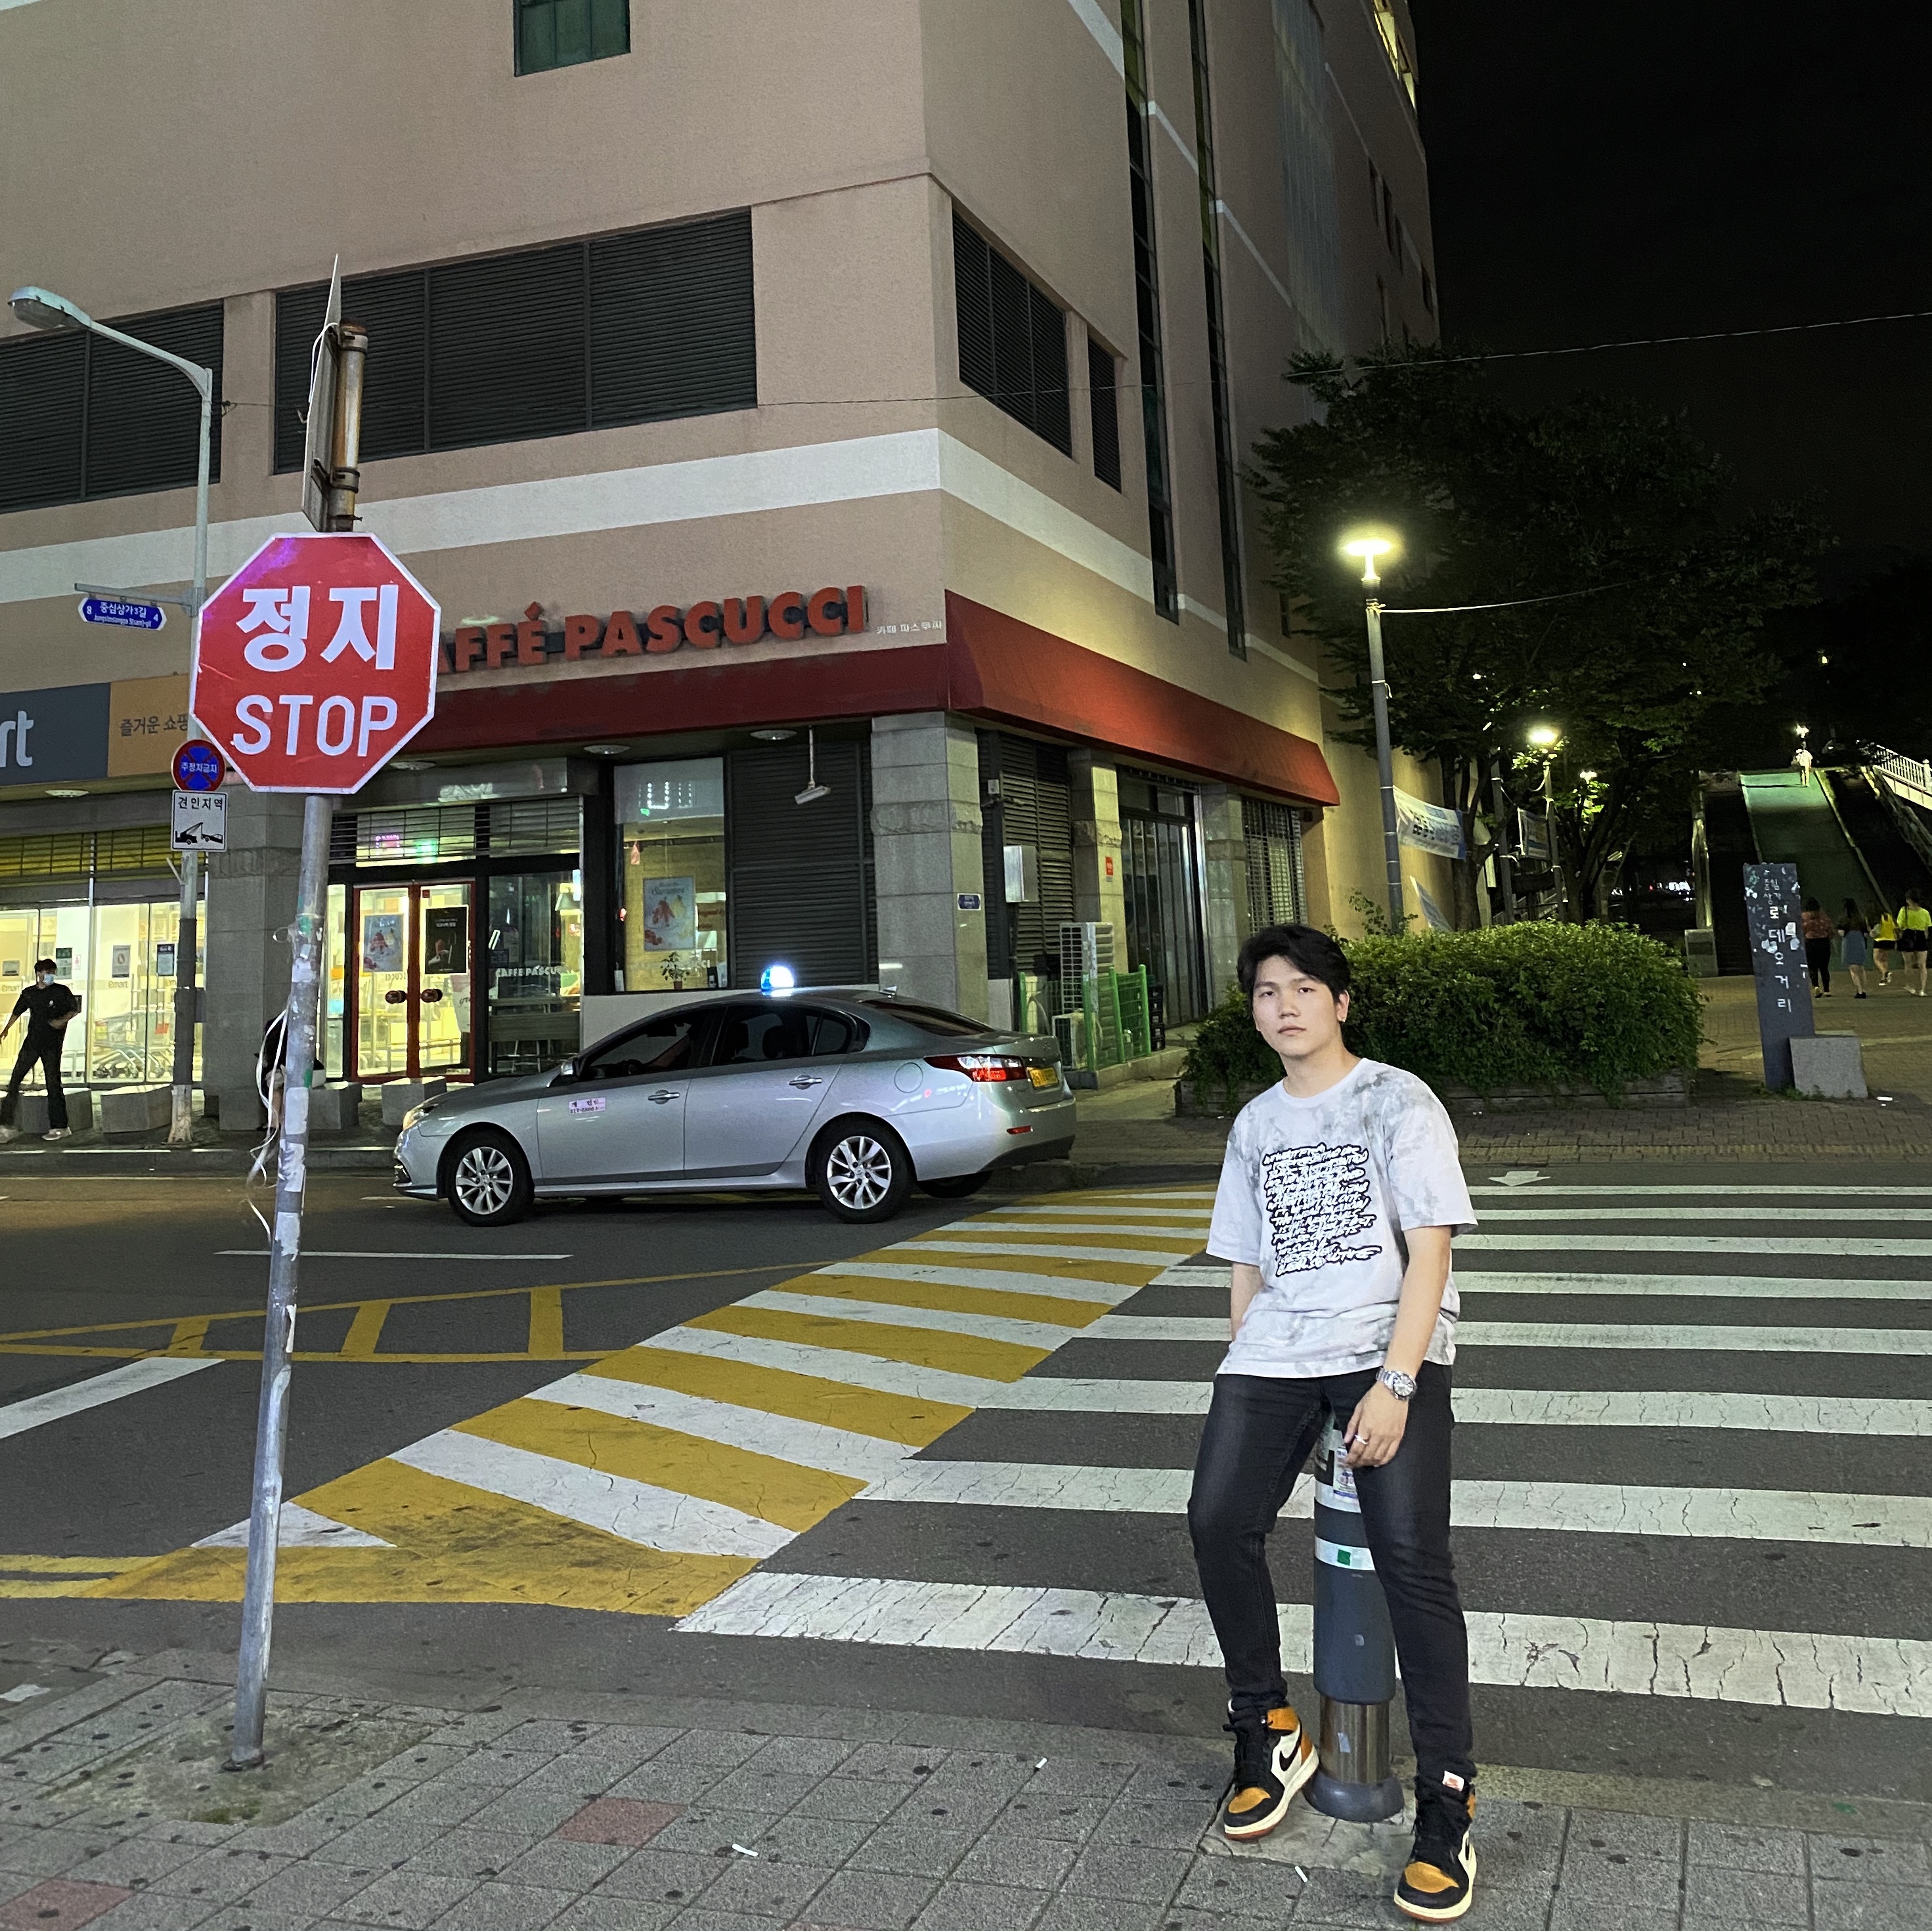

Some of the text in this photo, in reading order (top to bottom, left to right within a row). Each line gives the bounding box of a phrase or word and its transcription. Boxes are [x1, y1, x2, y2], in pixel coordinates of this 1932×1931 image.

[100, 601, 146, 618] 중심상가3길
[236, 585, 399, 672] 정지
[564, 584, 868, 662] PASCUCCI
[876, 624, 896, 635] 카페
[120, 716, 160, 737] 즐거운
[232, 694, 398, 757] STOP
[177, 796, 224, 812] 견인지역
